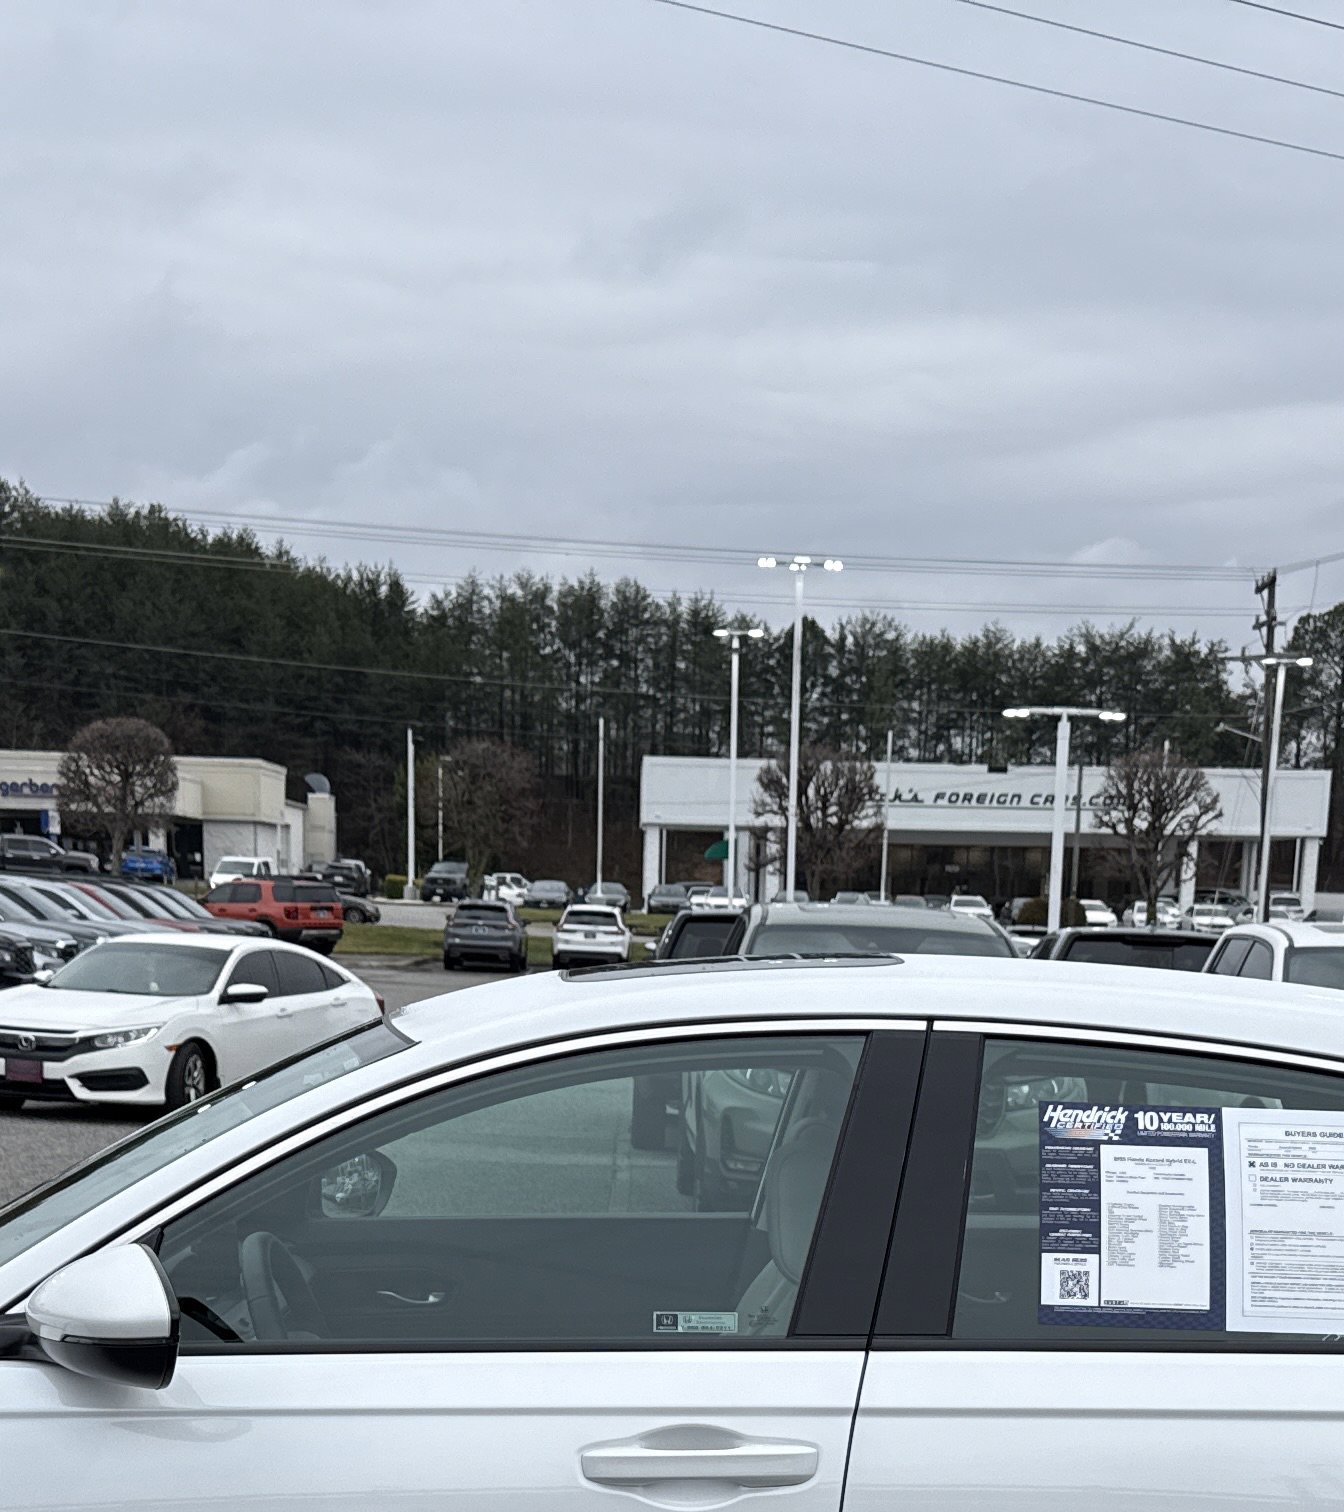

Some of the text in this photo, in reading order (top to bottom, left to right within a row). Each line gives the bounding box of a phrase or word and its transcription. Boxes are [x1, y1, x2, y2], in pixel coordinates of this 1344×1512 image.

[932, 792, 1023, 806] FOREIGN
[1043, 1104, 1129, 1128] Hendrick
[1134, 1110, 1160, 1131] 10
[1056, 1122, 1124, 1130] CERTIFIED
[1284, 1130, 1318, 1138] BUYERS
[1296, 1162, 1327, 1170] DEALER
[1291, 1177, 1334, 1185] WARRANTY
